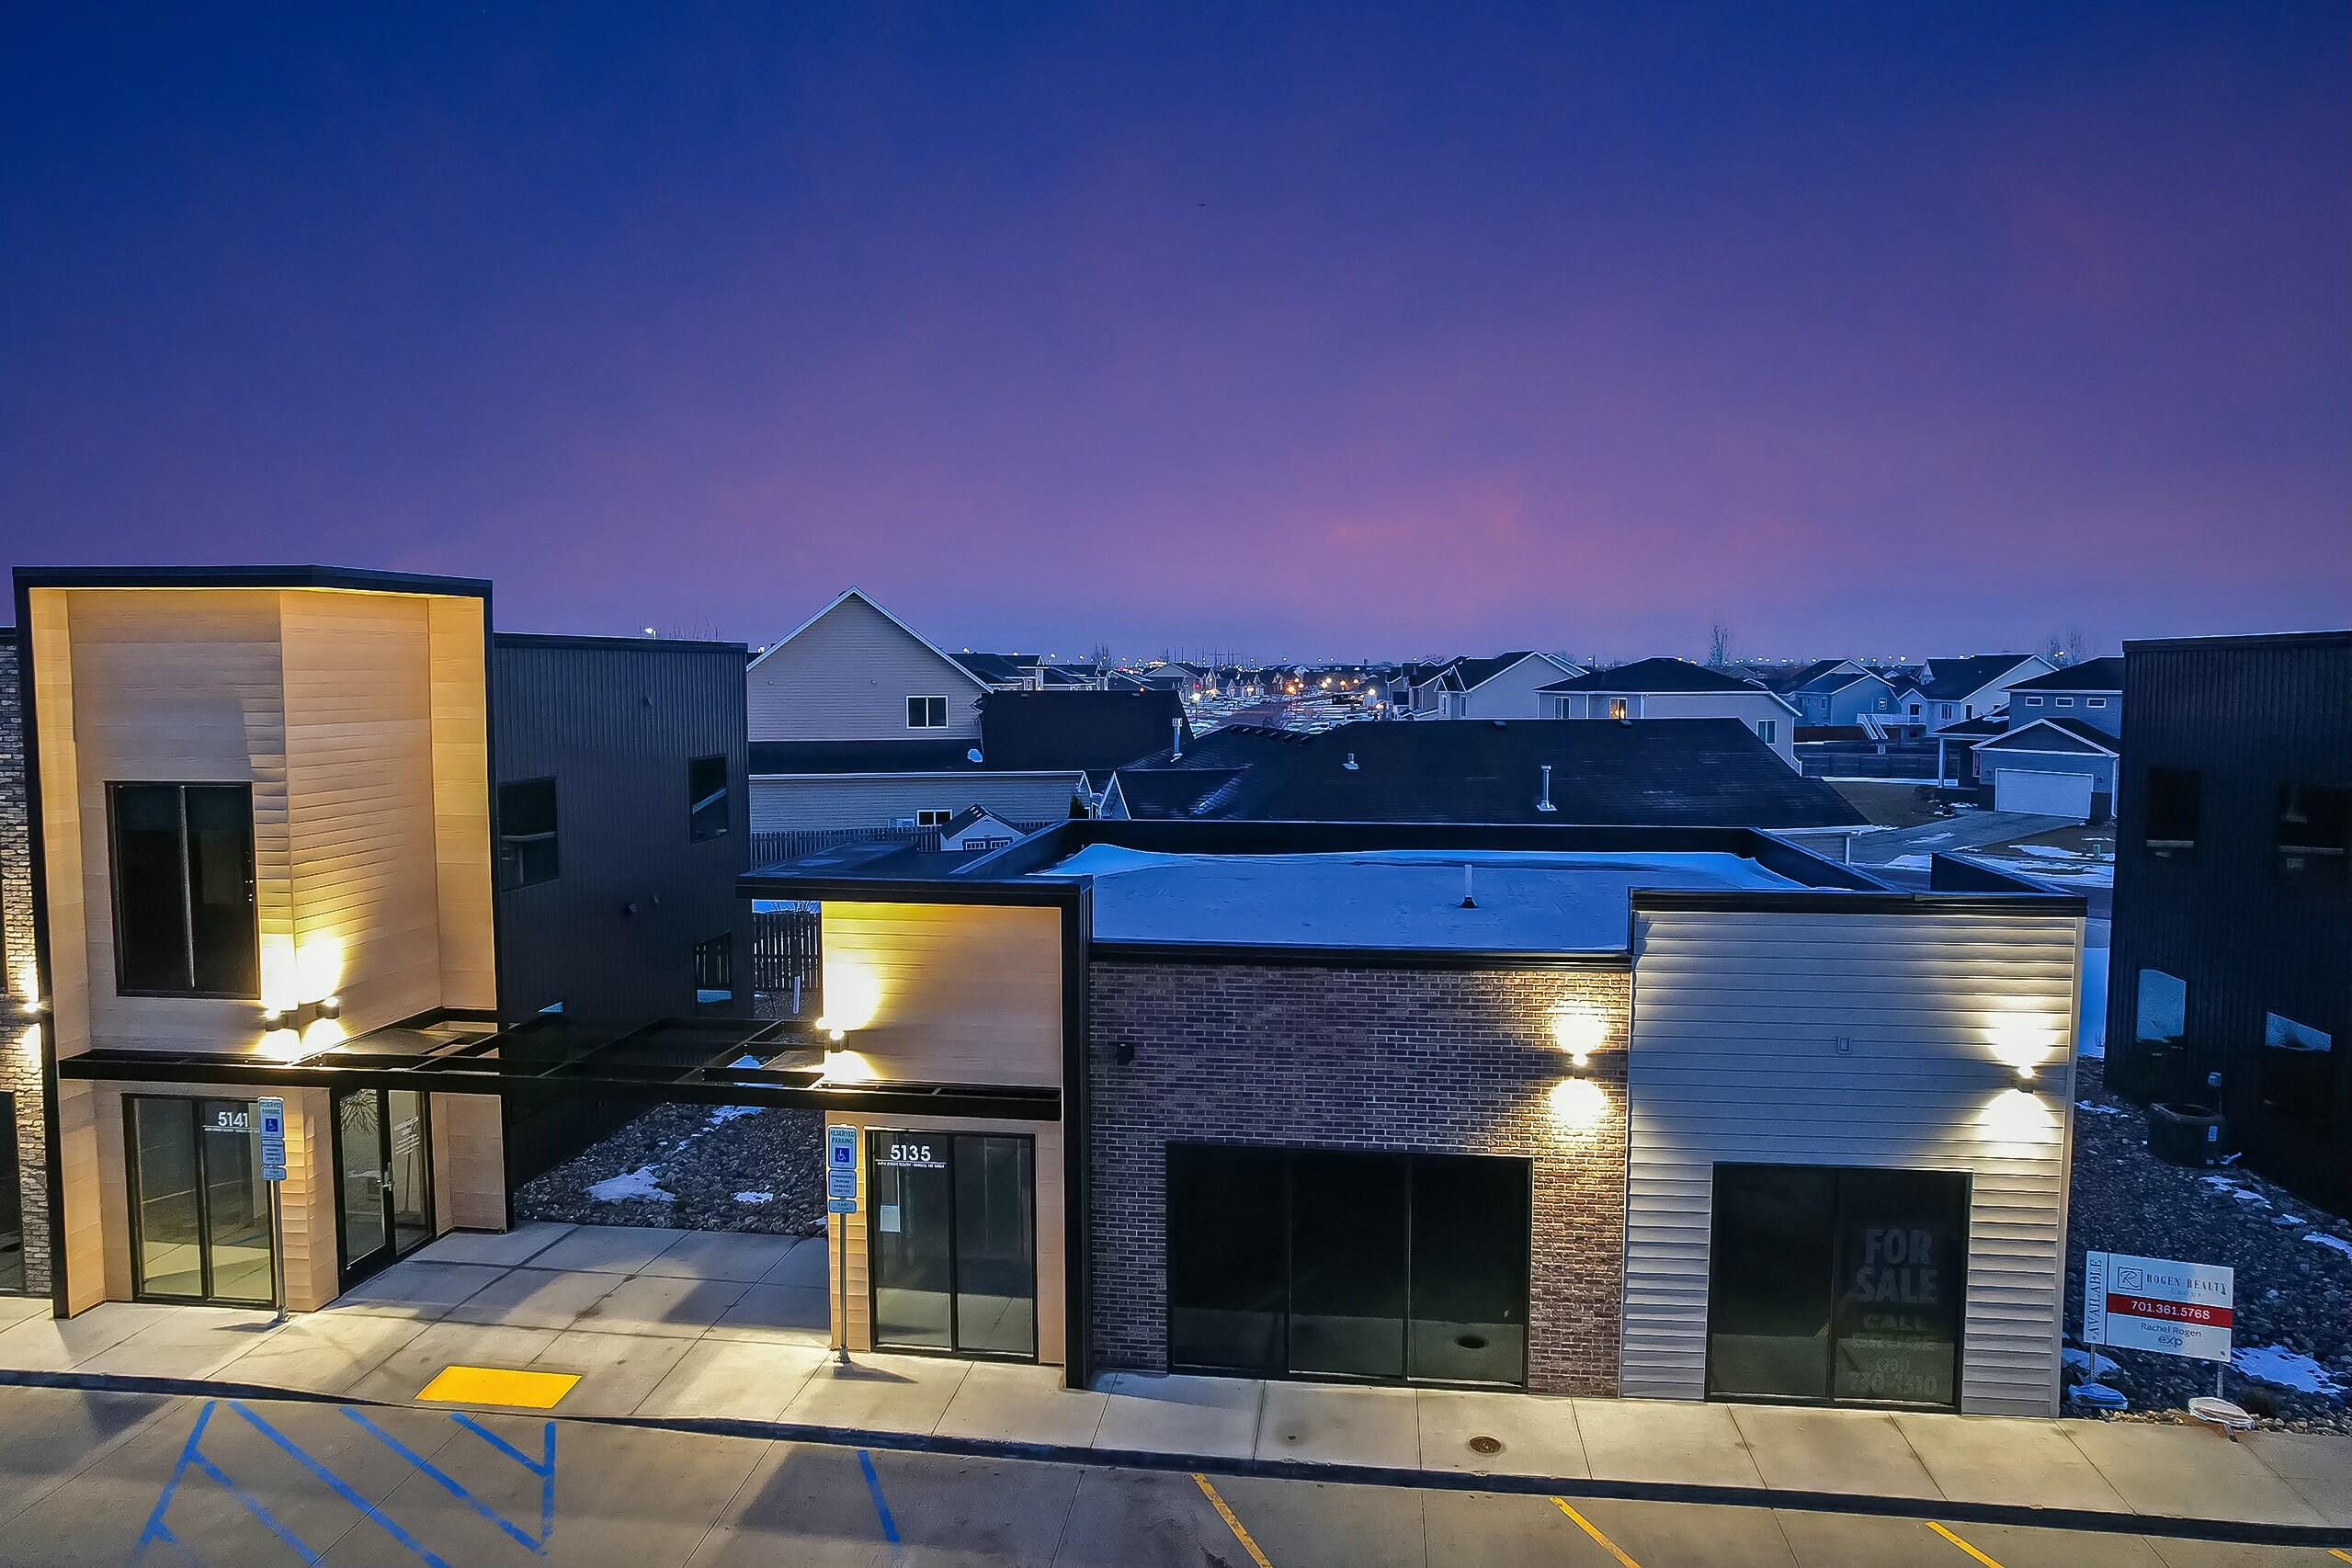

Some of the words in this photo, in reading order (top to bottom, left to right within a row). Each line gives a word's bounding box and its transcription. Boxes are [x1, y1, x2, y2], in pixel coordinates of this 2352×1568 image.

[218, 1112, 248, 1127] 5141
[890, 1144, 931, 1161] 5135
[1865, 1228, 1932, 1265] FOR
[1854, 1267, 1938, 1303] SALE
[2146, 1273, 2181, 1287] ROGEN
[2187, 1278, 2227, 1296] REALTY
[2087, 1259, 2102, 1336] AVAILABLE
[2131, 1301, 2210, 1320] 701.361.5768
[2141, 1322, 2172, 1334] Rachel
[2173, 1326, 2202, 1338] Rogen
